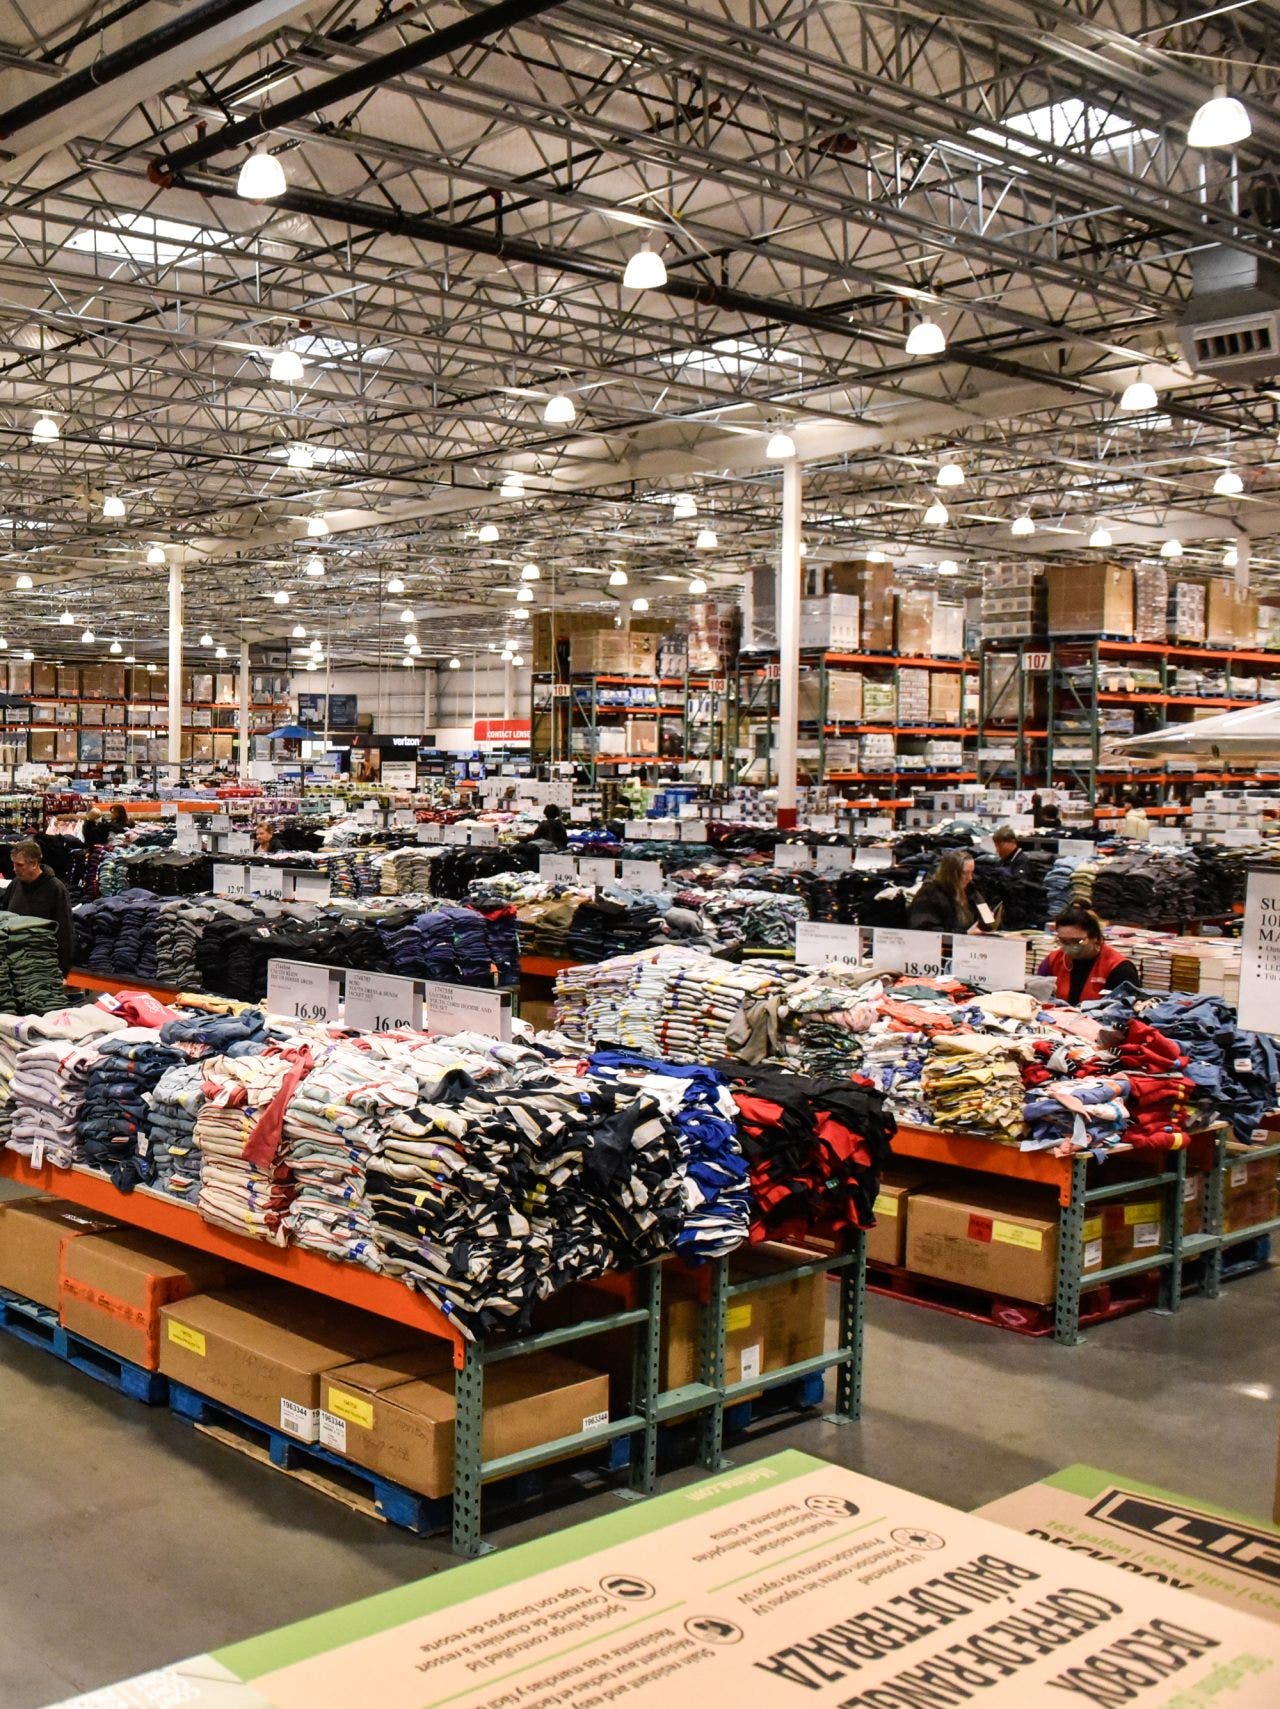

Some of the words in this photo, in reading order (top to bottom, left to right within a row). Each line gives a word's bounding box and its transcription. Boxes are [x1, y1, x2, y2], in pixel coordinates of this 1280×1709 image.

[1028, 655, 1047, 668] 107
[768, 665, 780, 677] 10
[554, 686, 567, 695] 101
[711, 680, 725, 691] 103
[393, 737, 420, 746] verizon
[228, 886, 244, 894] 12.97
[904, 962, 939, 975] 18.99
[295, 1003, 326, 1020] 16.99
[283, 1400, 307, 1416] 1963344
[321, 1413, 344, 1428] 1963344
[584, 1413, 608, 1426] 1963344
[747, 1505, 798, 1524] Resistente
[708, 1528, 739, 1540] clima
[792, 1519, 835, 1537] Weather
[749, 1535, 795, 1555] resistant
[851, 1547, 903, 1568] Protection
[905, 1554, 925, 1562] UV
[797, 1560, 833, 1575] contra
[819, 1567, 853, 1582] contre
[856, 1560, 907, 1584] protected
[750, 1580, 786, 1595] rayos
[925, 1554, 1042, 1604] BAÚL
[554, 1585, 590, 1599] Tapa
[735, 1593, 758, 1603] UV
[764, 1589, 806, 1605] rayons
[534, 1596, 560, 1608] con
[547, 1596, 608, 1620] Couvercle
[748, 1604, 773, 1615] UV
[888, 1587, 974, 1625] DE
[481, 1605, 539, 1627] bisagras
[545, 1604, 627, 1637] Spring-hinge
[985, 1587, 1123, 1655] COFFRE
[419, 1632, 469, 1651] resorte
[470, 1624, 534, 1649] charnière
[609, 1628, 677, 1656] Resistente
[482, 1635, 551, 1663] controlled
[636, 1639, 696, 1664] Résistant
[753, 1606, 939, 1690] TERRAZA
[946, 1634, 1036, 1676] DE
[1100, 1618, 1222, 1677] DECK
[413, 1651, 465, 1672] ressort
[678, 1648, 718, 1665] Stain
[612, 1661, 640, 1674] aux
[626, 1662, 685, 1688] resistant
[525, 1666, 586, 1692] manchas
[571, 1672, 618, 1691] taches
[1045, 1655, 1158, 1709] BOX
[600, 1685, 632, 1700] and
[567, 1695, 606, 1709] easy
